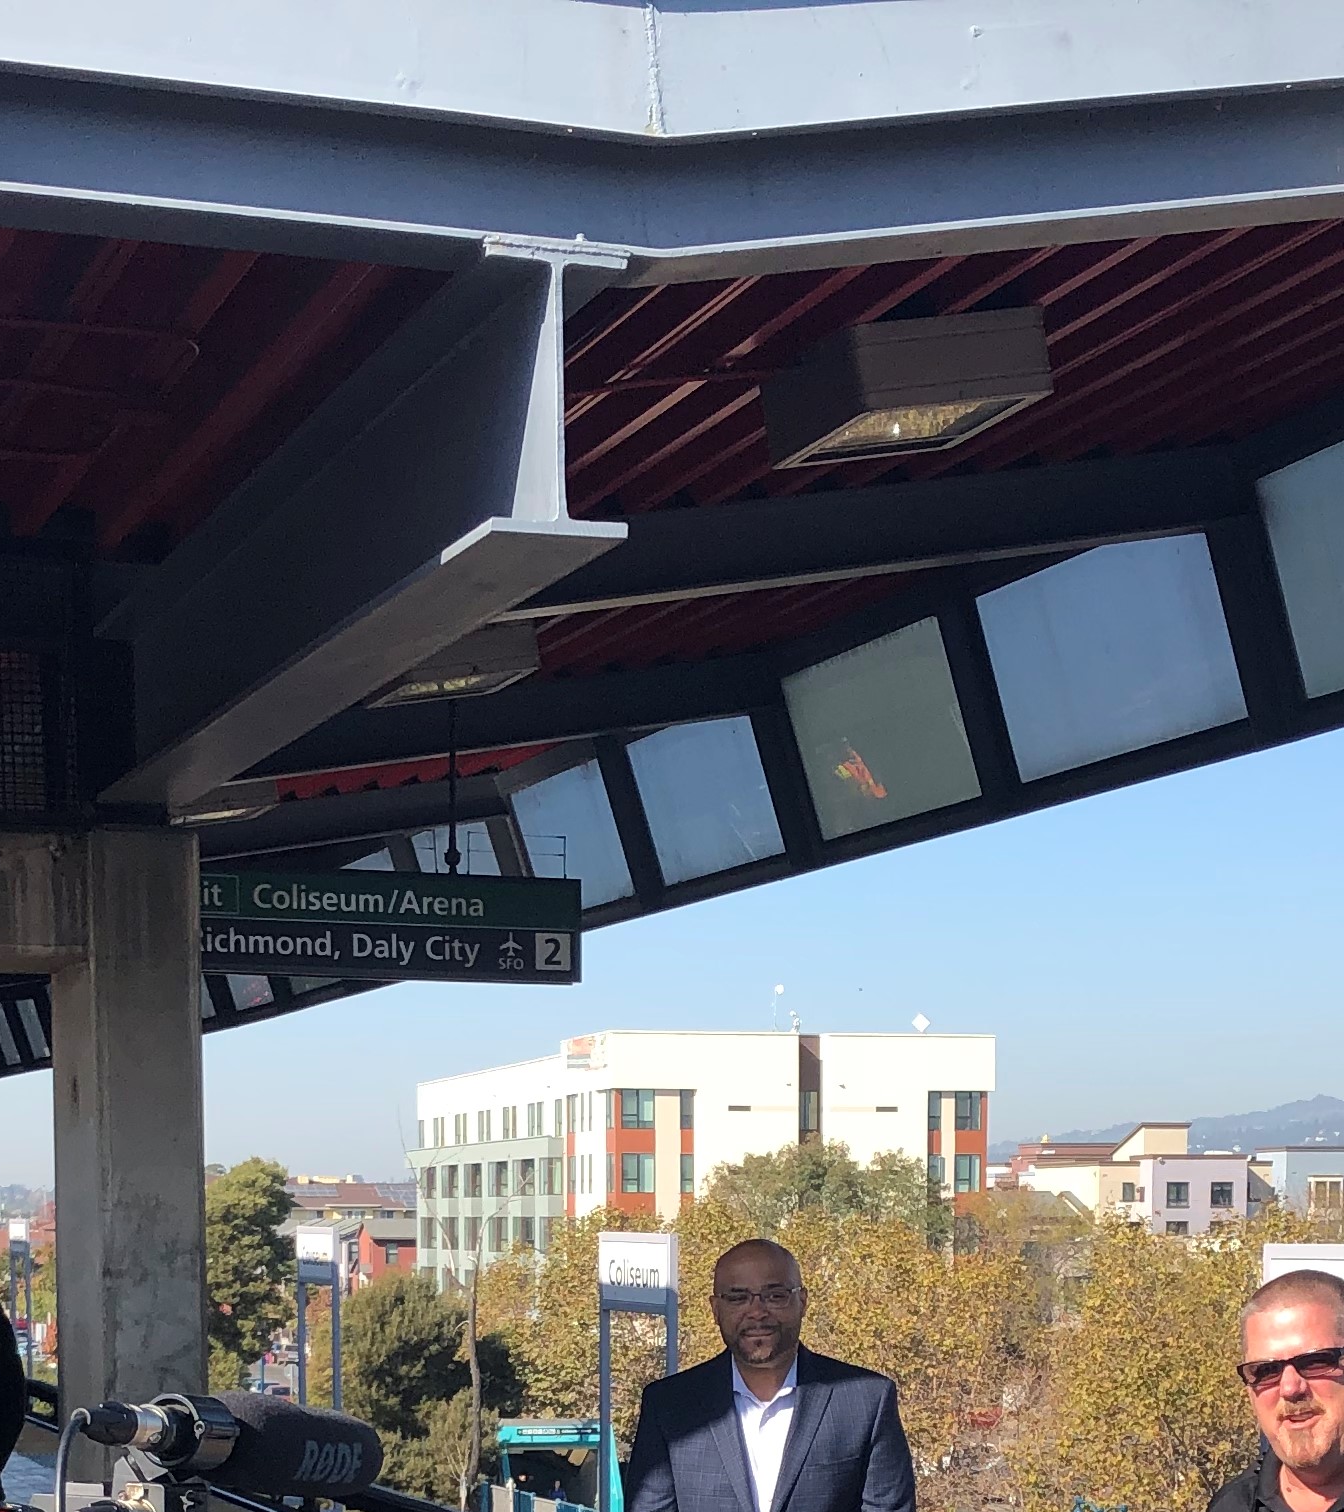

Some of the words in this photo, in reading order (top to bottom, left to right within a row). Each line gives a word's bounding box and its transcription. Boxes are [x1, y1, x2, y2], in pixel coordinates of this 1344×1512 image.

[201, 882, 223, 908] it
[253, 883, 485, 918] Coliseum/Arena
[351, 933, 416, 967] Daly
[425, 935, 481, 969] City
[544, 939, 563, 966] 2
[497, 957, 525, 971] SFO
[608, 1259, 660, 1289] Coliseum
